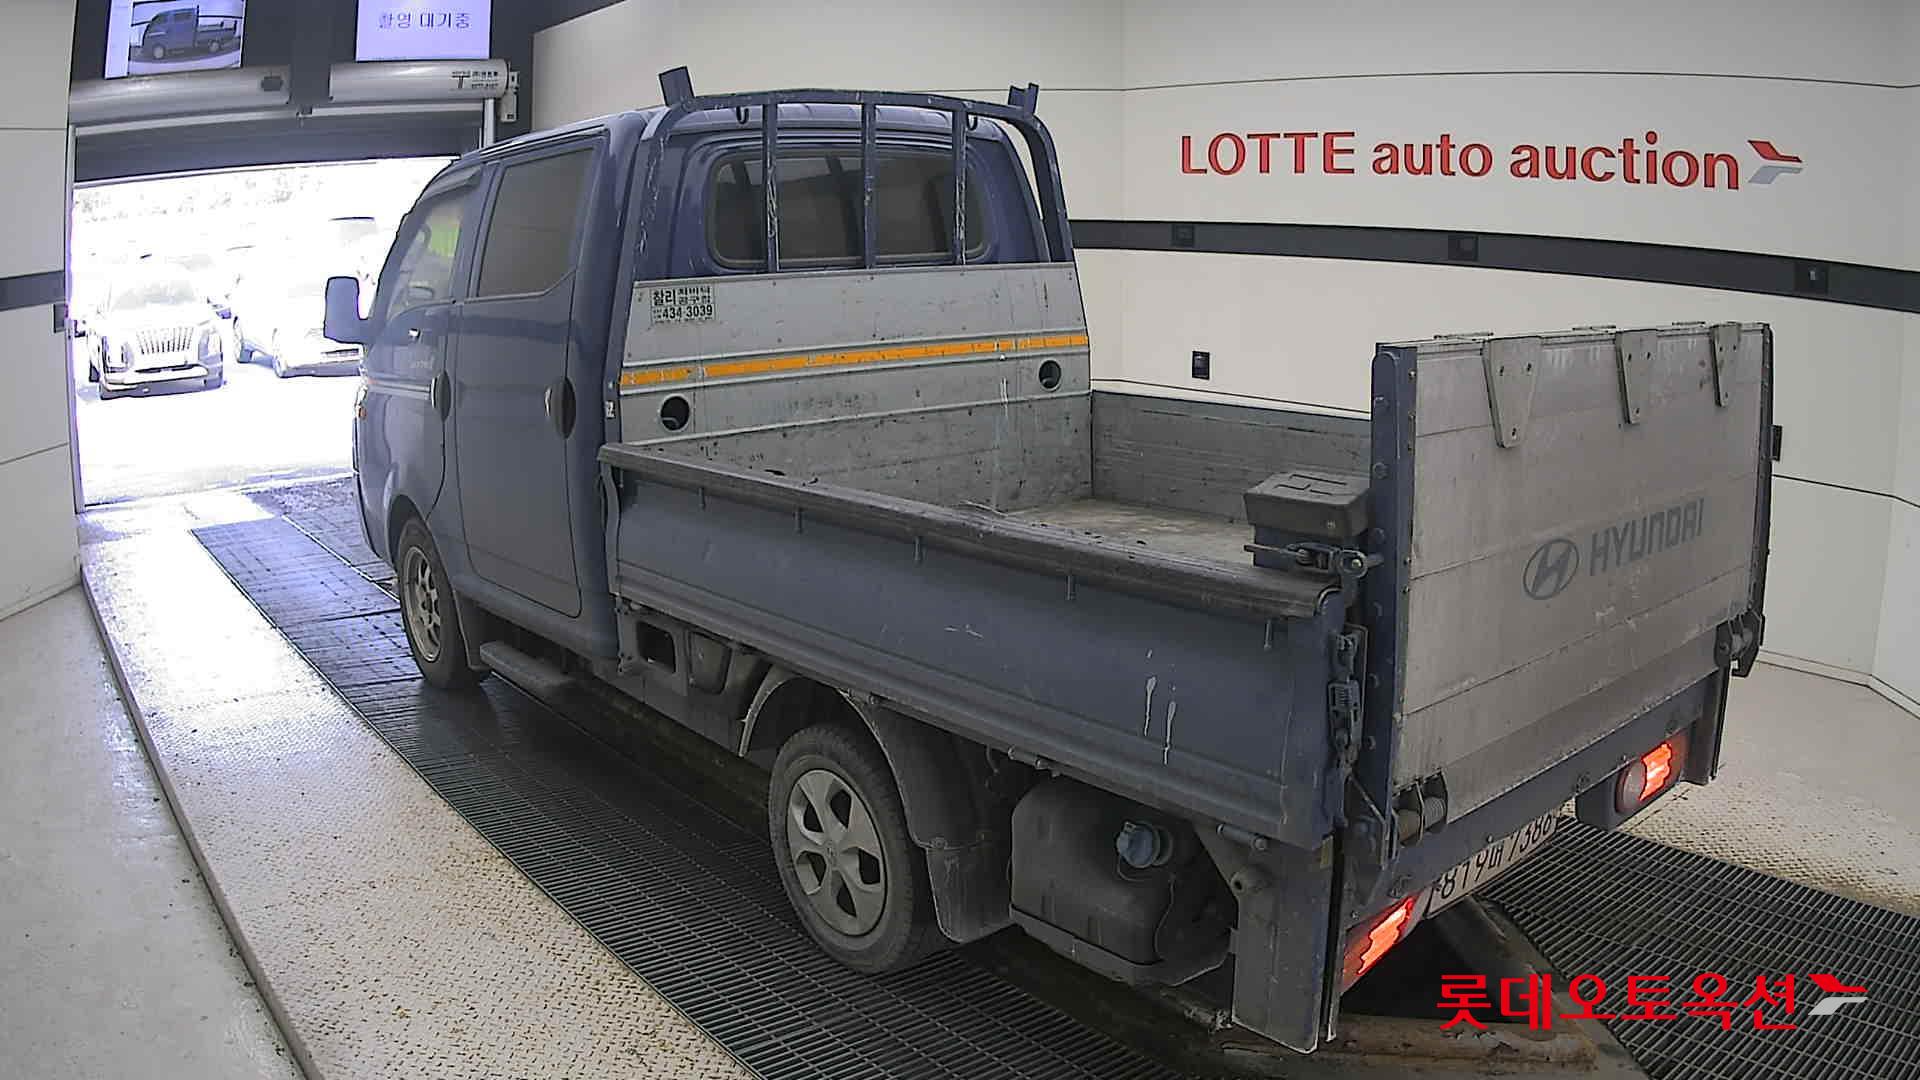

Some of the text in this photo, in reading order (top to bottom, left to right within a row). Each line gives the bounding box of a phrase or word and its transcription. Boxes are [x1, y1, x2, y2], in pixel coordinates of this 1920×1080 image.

[420, 12, 470, 29] 대기중
[1180, 131, 1740, 190] LOTTE auto auction
[1589, 498, 1705, 576] HYUNDAI
